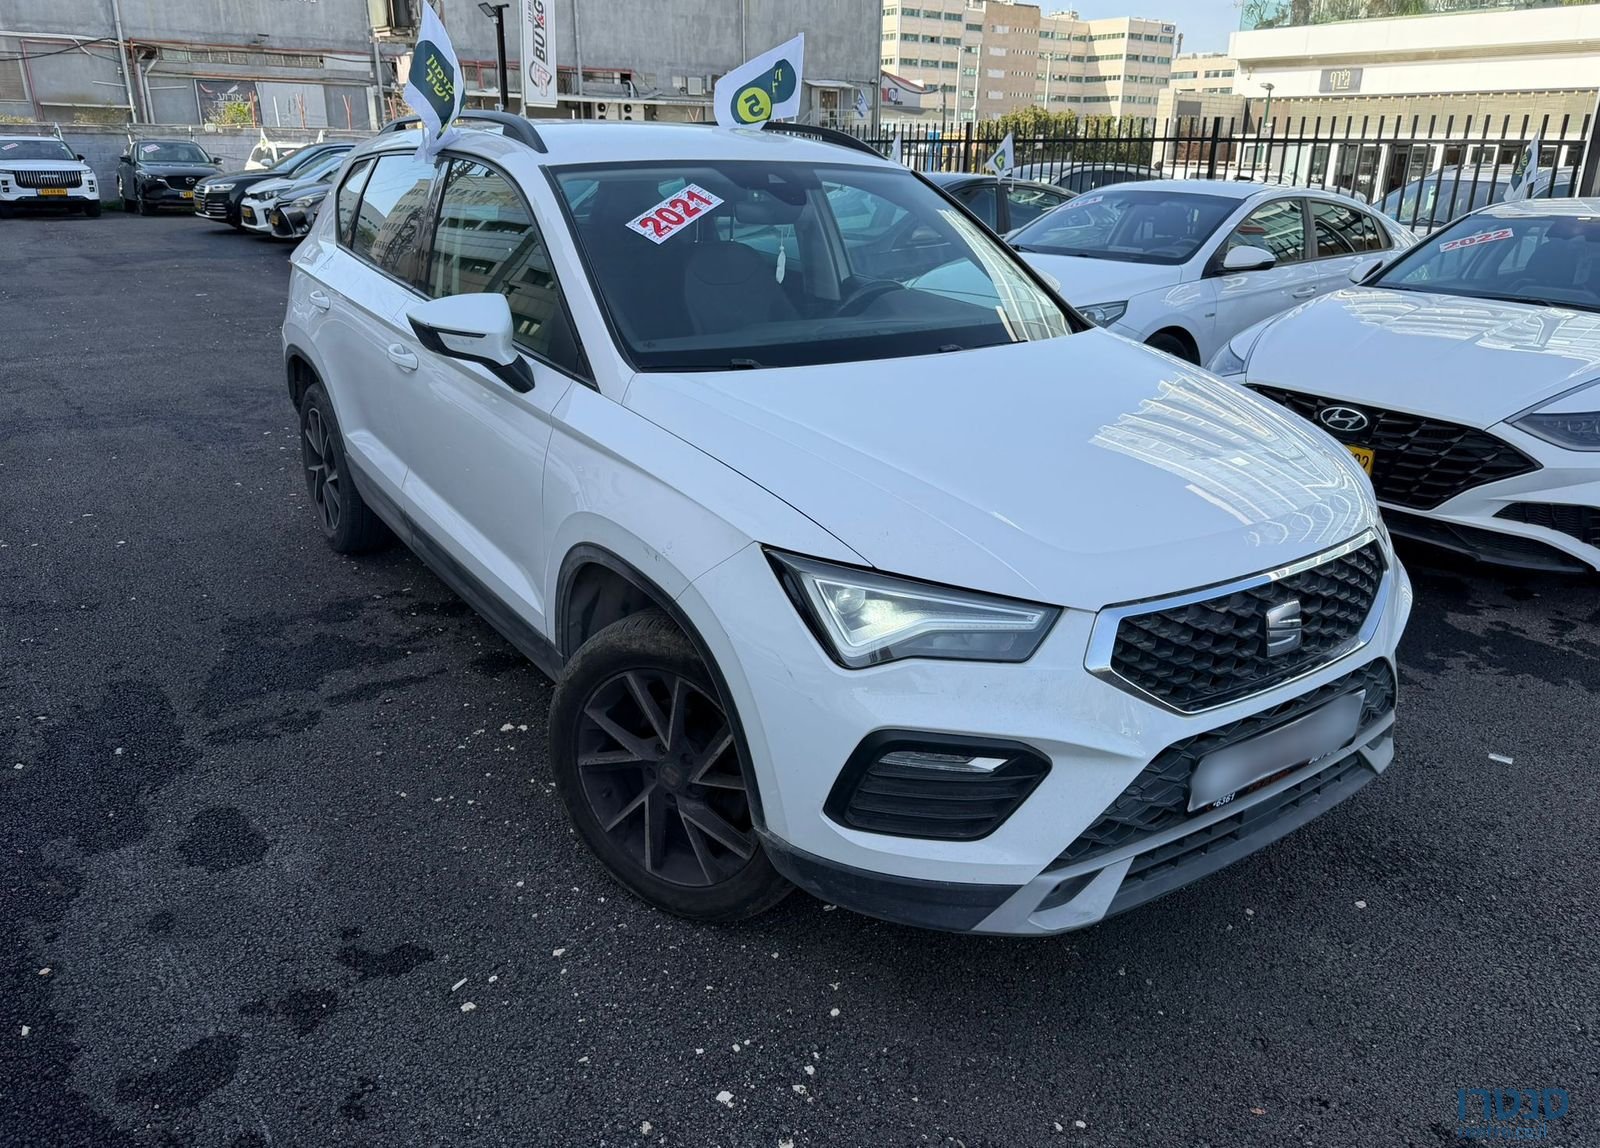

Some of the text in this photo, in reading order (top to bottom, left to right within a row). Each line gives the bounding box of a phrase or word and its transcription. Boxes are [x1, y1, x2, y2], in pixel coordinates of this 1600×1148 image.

[426, 54, 454, 95] מימון
[426, 68, 450, 102] ישיר
[639, 189, 713, 238] 2021
[1443, 230, 1510, 251] 2022
